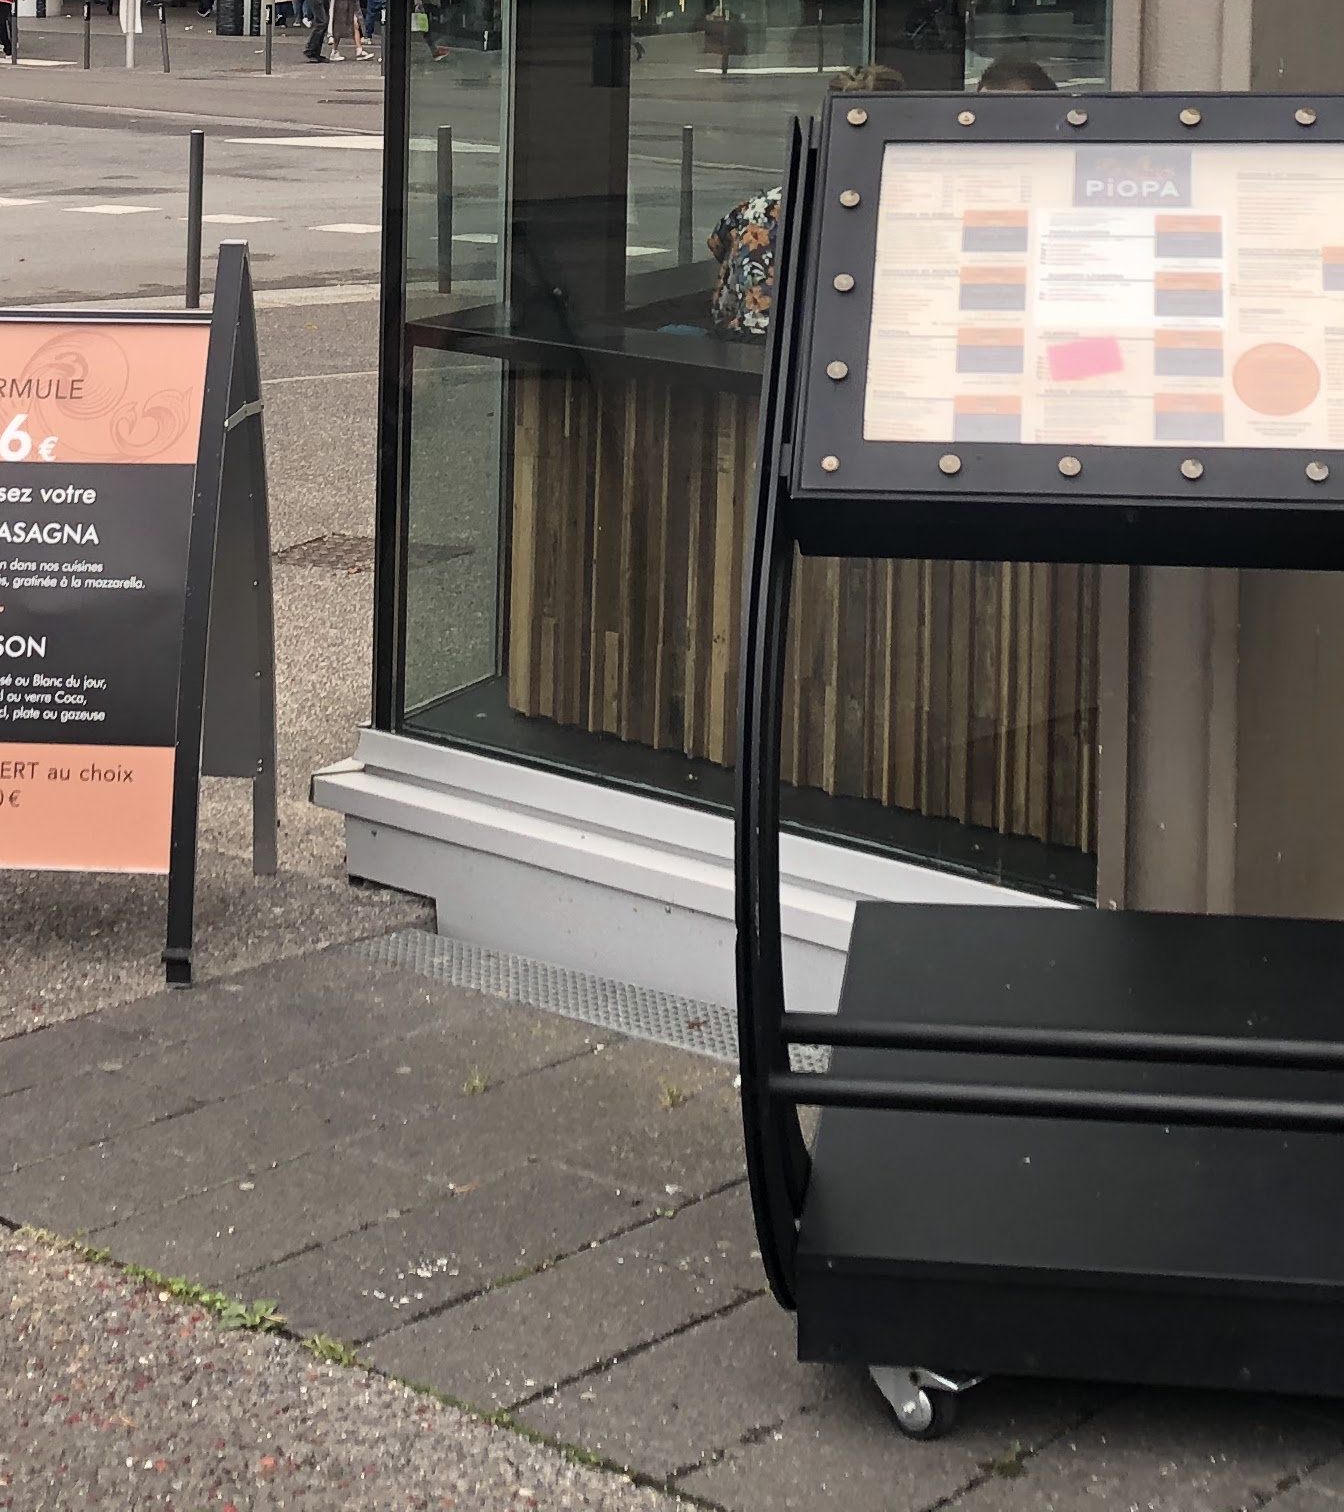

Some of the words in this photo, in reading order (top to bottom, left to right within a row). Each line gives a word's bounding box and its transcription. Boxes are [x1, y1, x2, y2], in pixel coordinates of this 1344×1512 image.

[40, 485, 96, 504] votre
[10, 558, 37, 571] dans
[39, 562, 59, 572] nos
[62, 560, 103, 572] cuisines
[12, 575, 57, 589] gratinée
[60, 576, 68, 587] à
[71, 576, 81, 587] la
[15, 676, 30, 687] ou
[32, 673, 63, 687] Blanc
[65, 674, 80, 688] du
[83, 675, 107, 691] jour,
[6, 692, 22, 703] ou
[24, 692, 52, 703] verre
[55, 691, 87, 706] Coca,
[12, 706, 40, 721] plate
[42, 710, 57, 720] ou
[60, 710, 106, 723] gazeuse
[47, 767, 70, 781] au
[79, 762, 134, 783] choix
